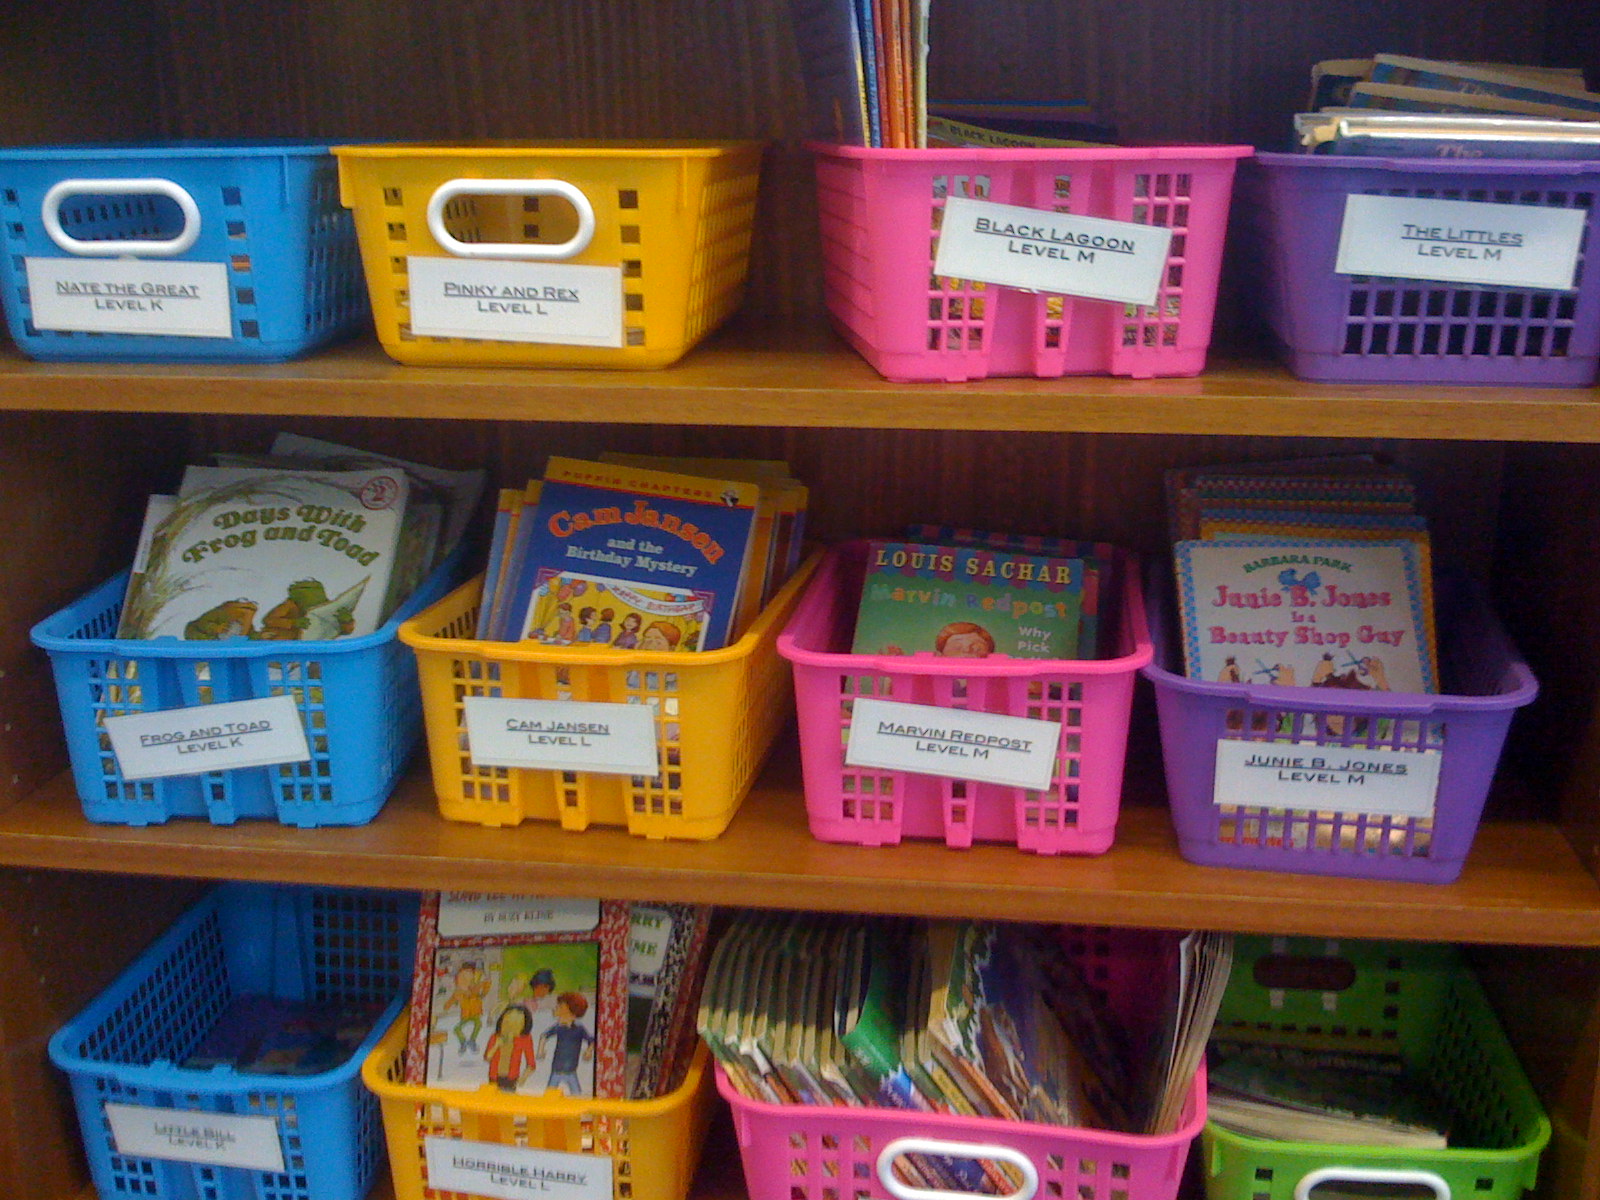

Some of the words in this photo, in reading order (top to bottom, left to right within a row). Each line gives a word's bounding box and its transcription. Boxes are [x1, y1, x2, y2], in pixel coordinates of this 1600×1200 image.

[976, 217, 1044, 239] BLACK
[1050, 229, 1135, 252] LAGOON
[1403, 224, 1441, 239] THE
[1448, 228, 1523, 244] LITTLES
[1008, 240, 1070, 260] LEVEL
[1077, 250, 1095, 263] M
[1418, 244, 1477, 259] LEVEL
[1484, 248, 1502, 260] M
[56, 281, 100, 295] NATE
[104, 282, 136, 295] THE
[141, 282, 200, 297] GREAT
[444, 282, 496, 296] PINKY
[502, 286, 538, 299] AND
[543, 286, 579, 300] REX
[95, 298, 147, 311] LEVEL
[151, 299, 164, 311] K
[477, 300, 531, 314] LEVEL
[537, 303, 548, 315] L
[628, 480, 713, 498] CHAPTERS
[212, 507, 290, 530] Days
[296, 504, 367, 533] With
[548, 506, 623, 538] Cam
[623, 500, 725, 565] Jansen
[182, 529, 257, 563] Frog
[263, 525, 316, 541] and
[316, 528, 380, 566] Toad
[607, 537, 635, 551] and
[639, 540, 664, 555] the
[565, 546, 633, 568] Birthday
[634, 555, 698, 578] Mystery
[876, 550, 954, 572] LOUIS
[965, 558, 1071, 585] SACHAR
[1242, 554, 1310, 573] BARBARA
[1312, 556, 1352, 573] PARK
[870, 583, 957, 608] Marvin
[966, 592, 1067, 619] Redpost
[1212, 585, 1282, 609] Junie
[1289, 585, 1316, 607] B.
[1322, 584, 1393, 608] Jones
[1018, 626, 1051, 640] Why
[1209, 626, 1289, 647] Beauty
[1294, 626, 1350, 648] Shop
[1357, 625, 1405, 647] Guy
[1018, 641, 1049, 653] Pick
[140, 731, 185, 745] FROG
[190, 726, 222, 739] AND
[224, 720, 270, 733] TOAD
[506, 718, 542, 731] CAM
[546, 721, 609, 734] JANSEN
[878, 721, 945, 739] MARVIN
[950, 730, 1032, 750] REDPOST
[177, 740, 228, 754] LEVEL
[231, 737, 243, 747] K
[528, 734, 577, 746] LEVEL
[581, 736, 592, 746] L
[916, 741, 968, 757] LEVEL
[973, 747, 989, 760] M
[1245, 755, 1303, 768] JUNIE
[1311, 758, 1331, 769] B.
[1340, 760, 1408, 774] JONES
[1278, 770, 1340, 784] LEVEL
[1348, 775, 1365, 785] M
[453, 1156, 529, 1174] HORRIBLE
[534, 1166, 588, 1184] HARRY
[490, 1174, 537, 1189] LEVEL
[541, 1180, 550, 1191] L
